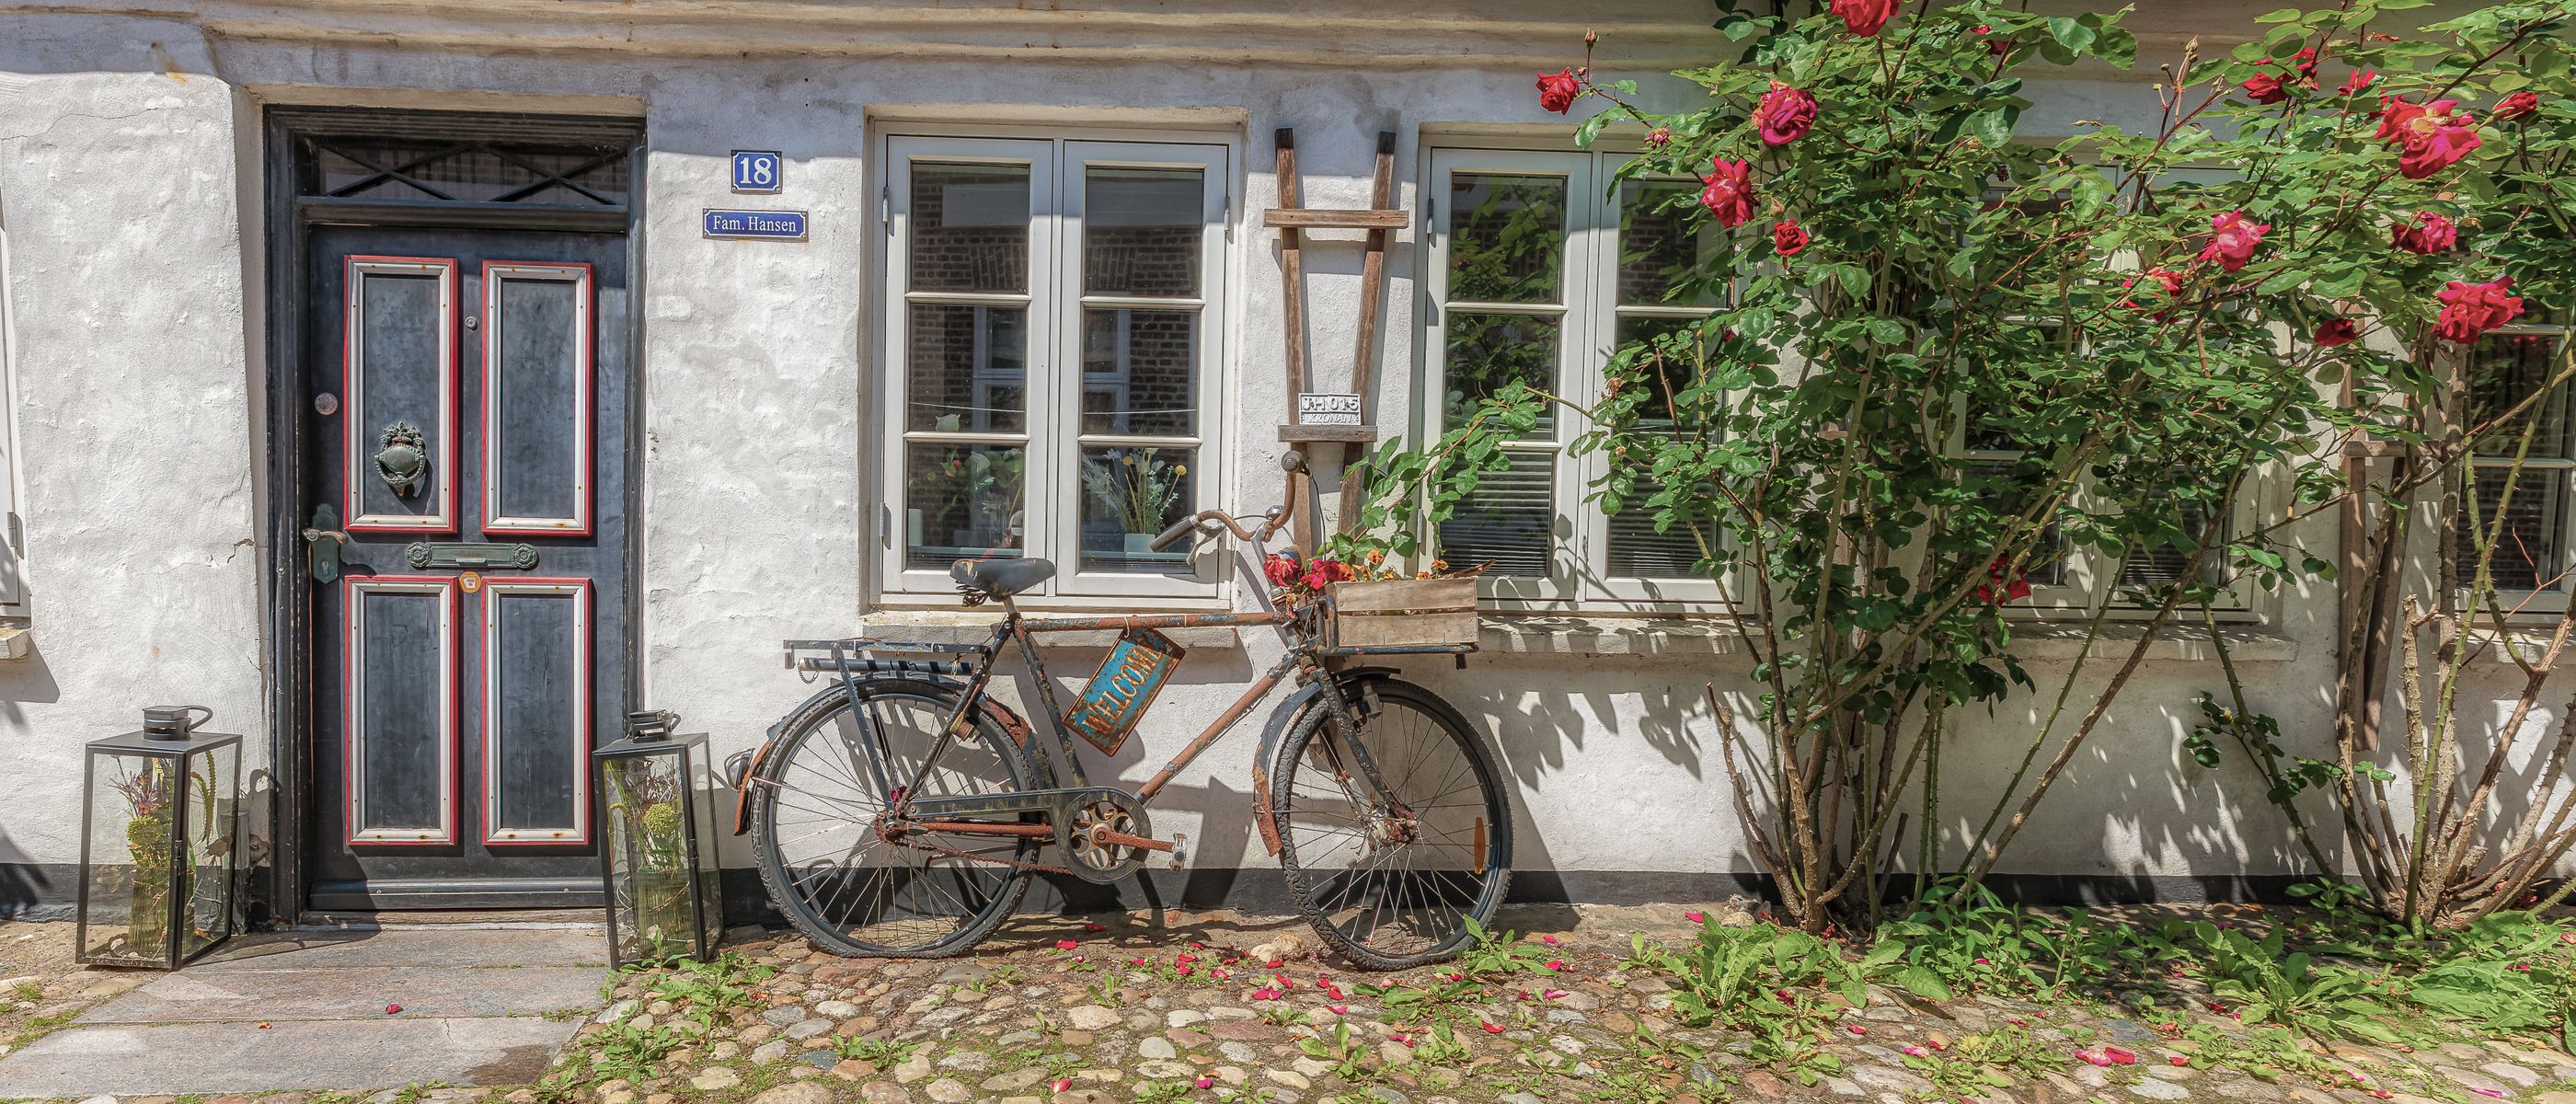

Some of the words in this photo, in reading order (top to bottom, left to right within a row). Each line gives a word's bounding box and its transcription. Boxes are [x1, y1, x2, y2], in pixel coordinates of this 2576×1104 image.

[740, 157, 772, 185] 18
[713, 215, 745, 231] Fam.
[748, 215, 797, 232] Hansen
[1308, 413, 1352, 424] KRONAN
